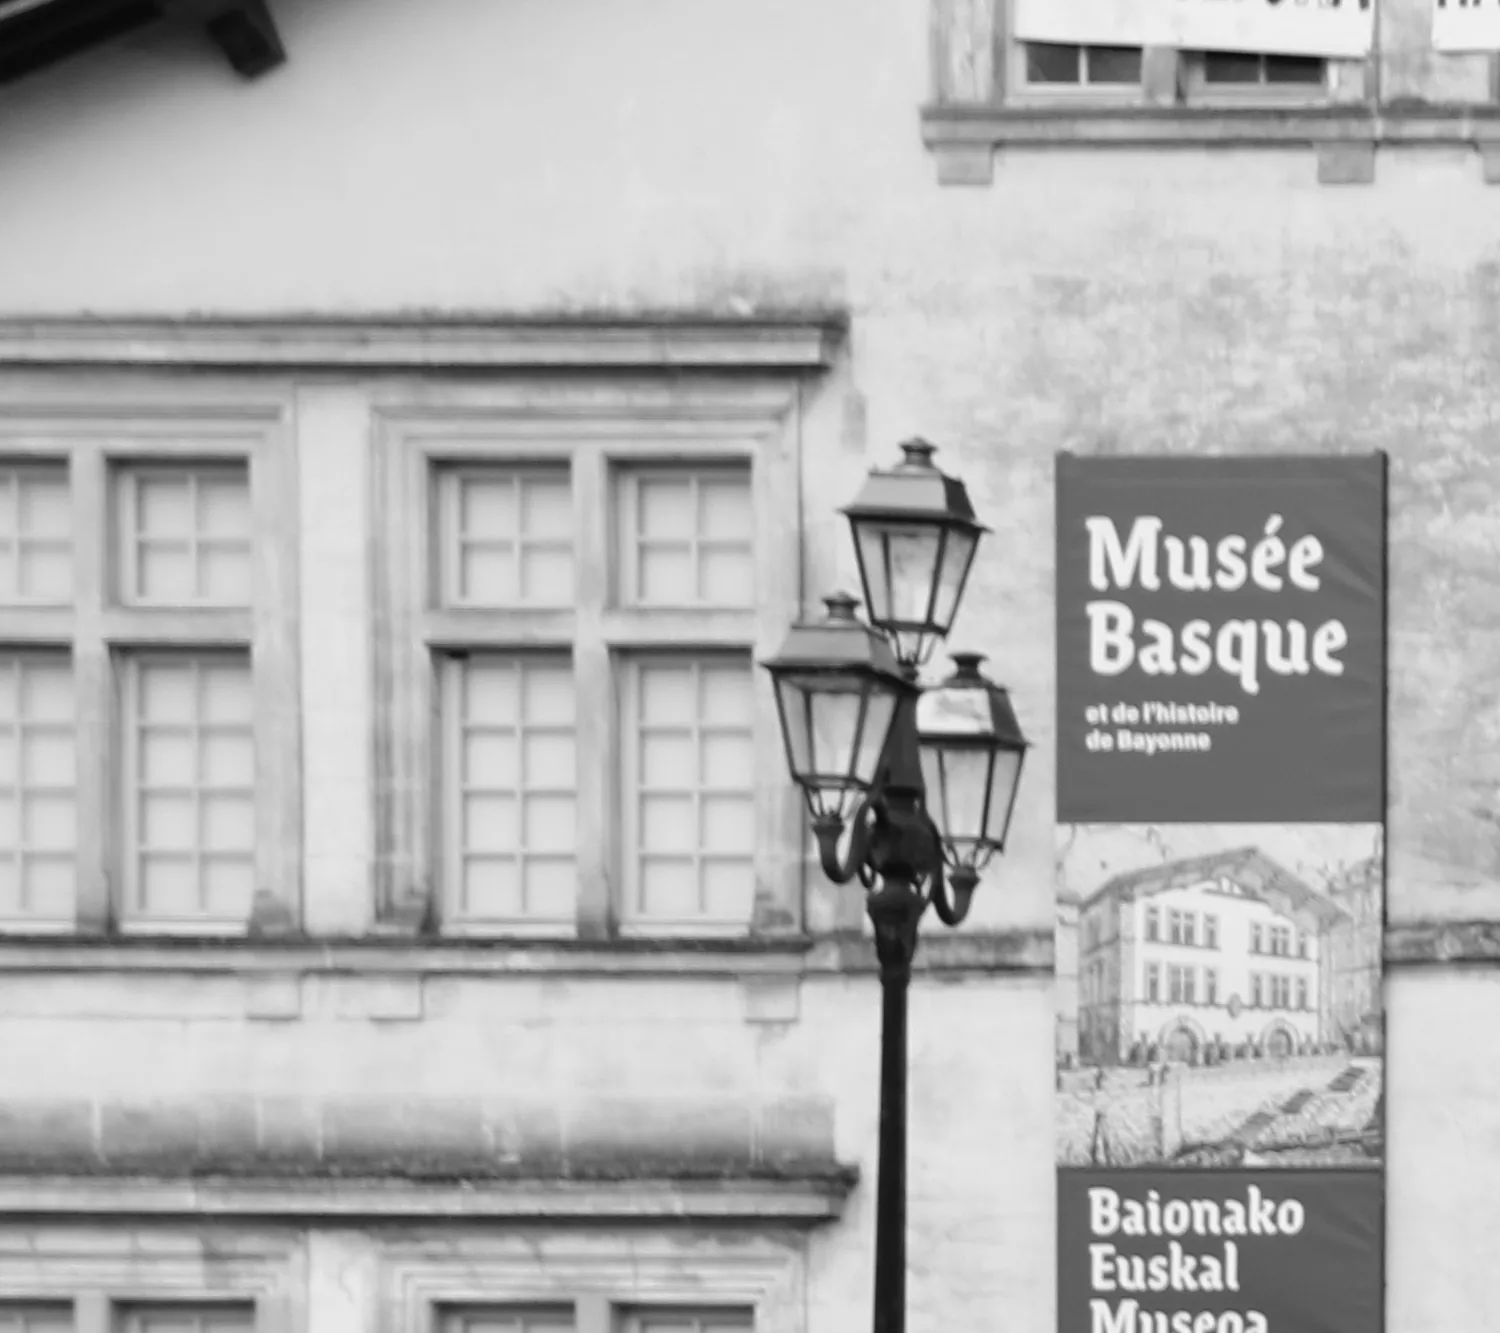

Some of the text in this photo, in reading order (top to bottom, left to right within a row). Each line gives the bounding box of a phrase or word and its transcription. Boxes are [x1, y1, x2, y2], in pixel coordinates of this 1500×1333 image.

[1085, 513, 1324, 592] Musée
[1085, 600, 1348, 695] Basque
[1085, 701, 1240, 725] et de l'histoire
[1085, 728, 1212, 756] de Bayonne
[1088, 1184, 1305, 1236] Baionako
[1088, 1240, 1239, 1292] Euskal
